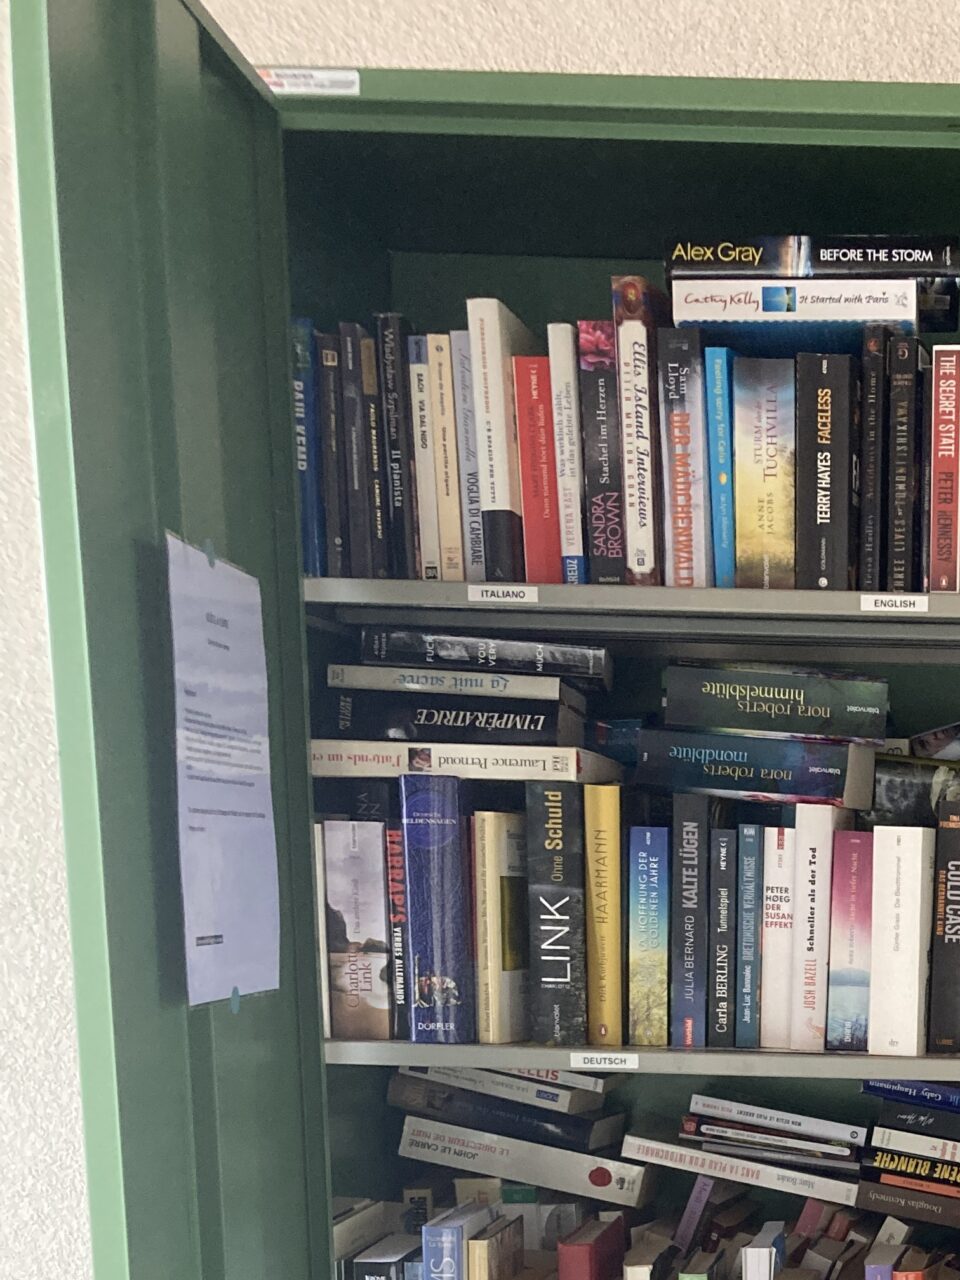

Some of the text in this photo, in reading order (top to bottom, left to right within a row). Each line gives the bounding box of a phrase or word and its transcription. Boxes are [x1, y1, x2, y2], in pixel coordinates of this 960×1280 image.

[672, 242, 762, 265] Alex Gray
[820, 249, 933, 262] BEFORE THE STORM
[684, 290, 759, 312] Cathy Kelly
[799, 292, 888, 304] It Started with Paris
[667, 363, 690, 399] Sam Lloyd
[817, 389, 832, 444] FACELESS
[939, 355, 957, 458] THE SECRET STATE
[632, 341, 650, 528] Ellis Island Interviews
[671, 413, 690, 448] DER
[817, 452, 831, 524] TERRY HAYES
[467, 472, 483, 566] VOGLIA DI CAMBIARE
[592, 493, 622, 557] SANDRA BROWN
[481, 590, 526, 599] ITALIANO
[874, 599, 916, 608] ENGLISH
[702, 682, 805, 705] himmelsblüte
[738, 699, 831, 717] nora roberts
[415, 709, 545, 730] L'IMPÉRATRICE
[438, 756, 546, 772] Laurence Pernoud
[669, 745, 748, 763] mondblüte
[703, 763, 793, 781] nora roberts
[544, 790, 563, 881] Ohne Schuld
[682, 821, 699, 908] KALTE LÜGEN
[806, 848, 817, 952] Schneller als der Tod
[539, 896, 571, 983] LINK
[684, 916, 696, 1002] JULIA BERNARD
[716, 944, 728, 1033] Carla BERLING
[583, 1057, 626, 1065] DEUTSCH
[873, 1152, 931, 1176] BLANCHE
